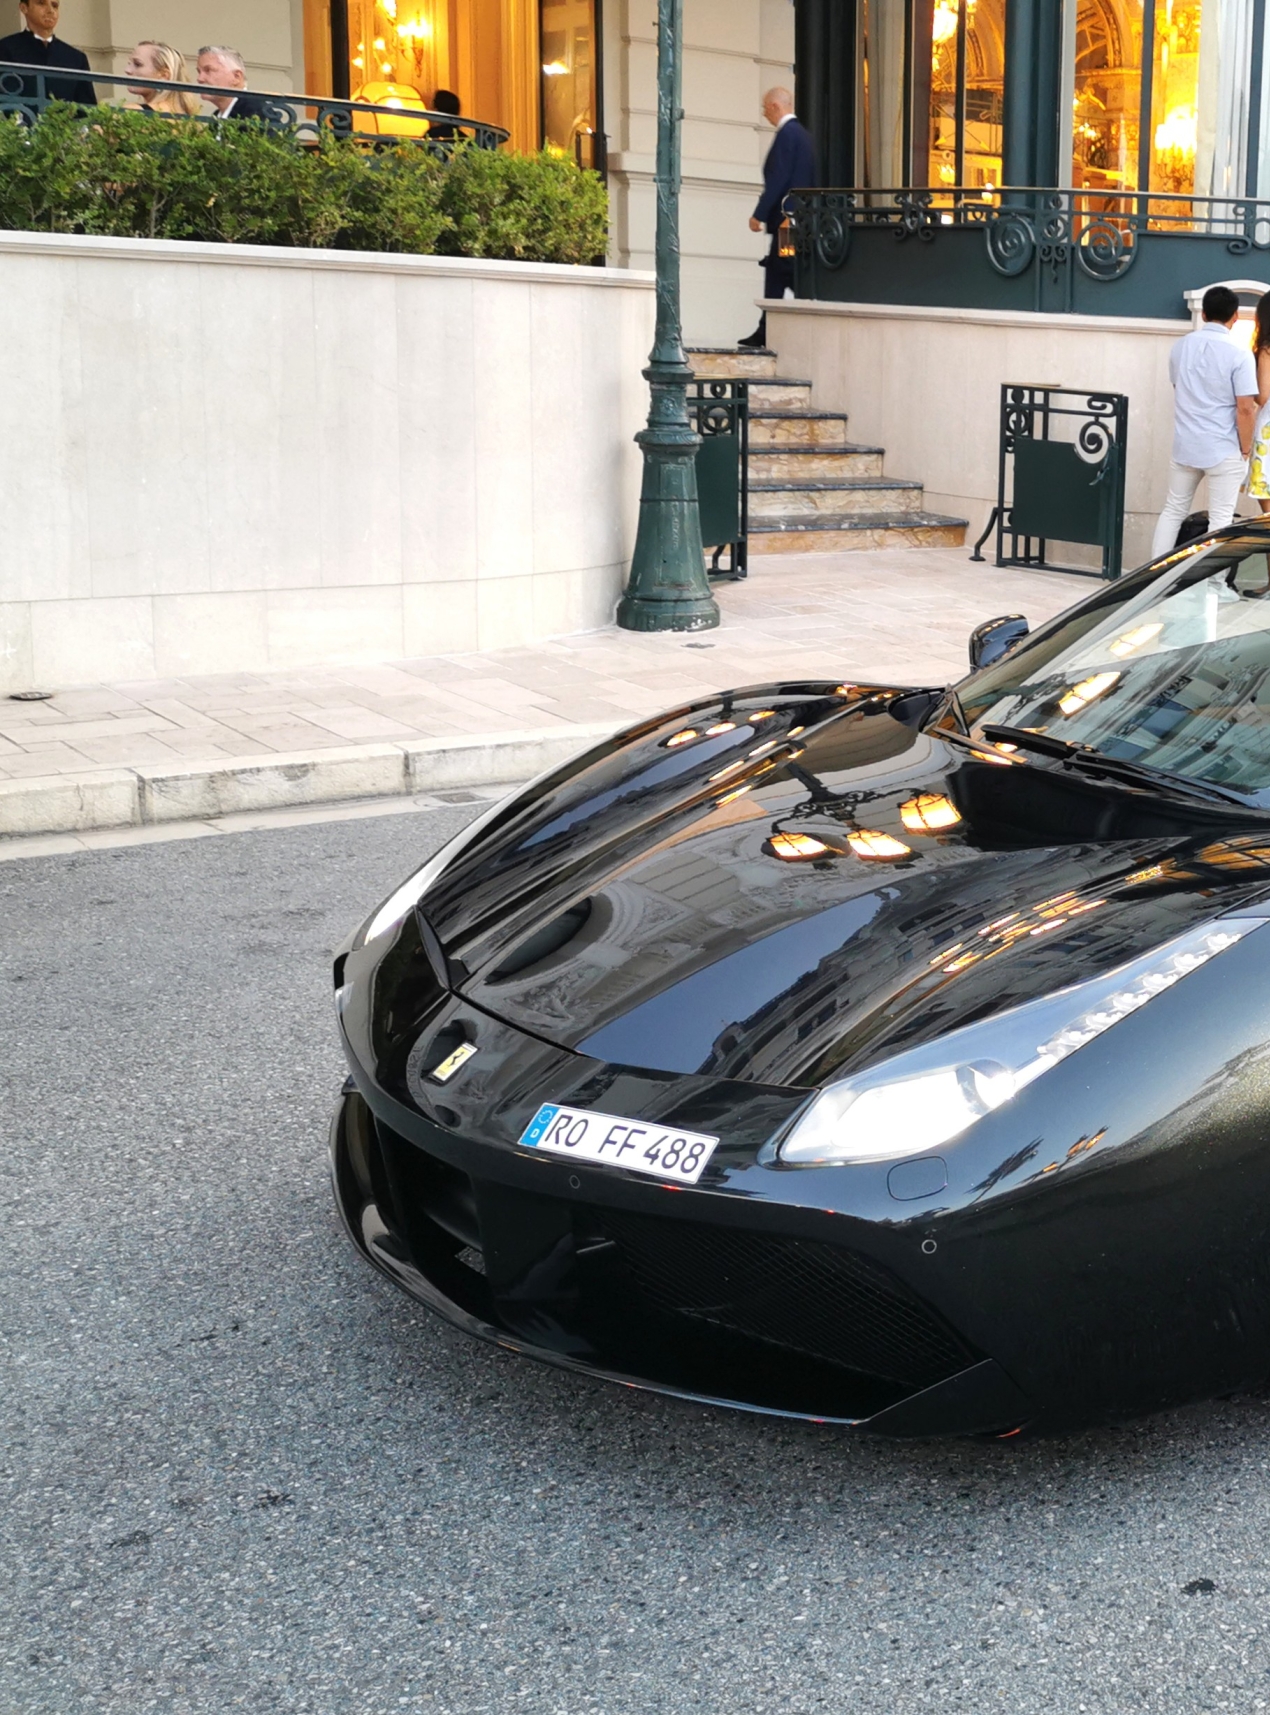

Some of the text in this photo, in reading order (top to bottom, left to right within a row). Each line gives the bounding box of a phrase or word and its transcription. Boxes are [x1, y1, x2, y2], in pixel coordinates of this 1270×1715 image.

[530, 1128, 540, 1139] D
[544, 1114, 706, 1174] RO FF 488
